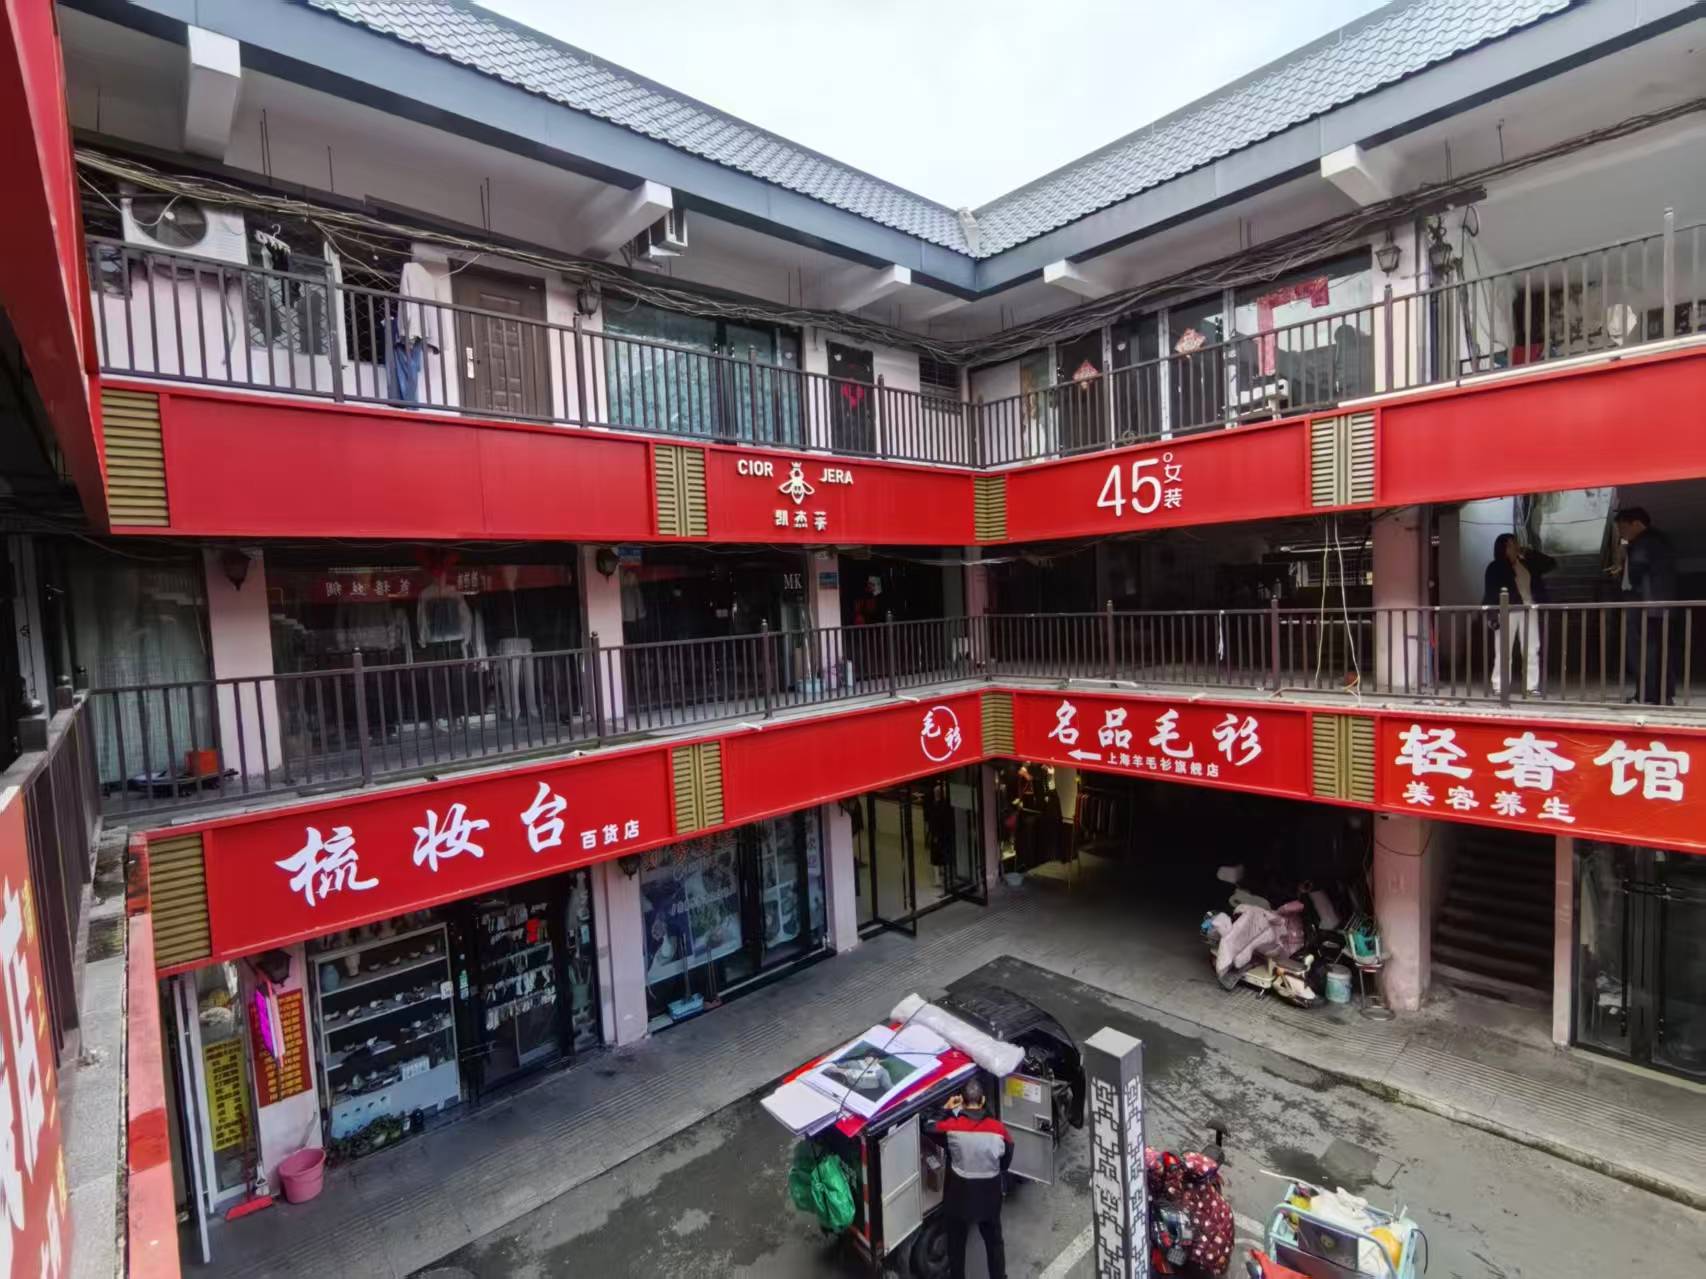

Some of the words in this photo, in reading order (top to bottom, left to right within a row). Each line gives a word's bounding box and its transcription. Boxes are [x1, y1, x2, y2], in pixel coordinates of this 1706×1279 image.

[737, 459, 774, 477] CIOR
[819, 468, 854, 485] JERA
[1163, 463, 1183, 509] 女装
[920, 708, 963, 752] 毛衫
[1047, 699, 1263, 768] 名品毛衫
[1106, 751, 1220, 778] 上海羊毛衫旗舰店
[1394, 723, 1690, 802] 轻奢馆
[1402, 780, 1576, 824] 美容养生
[275, 780, 569, 908] 梳妆台
[580, 818, 640, 850] 百货店
